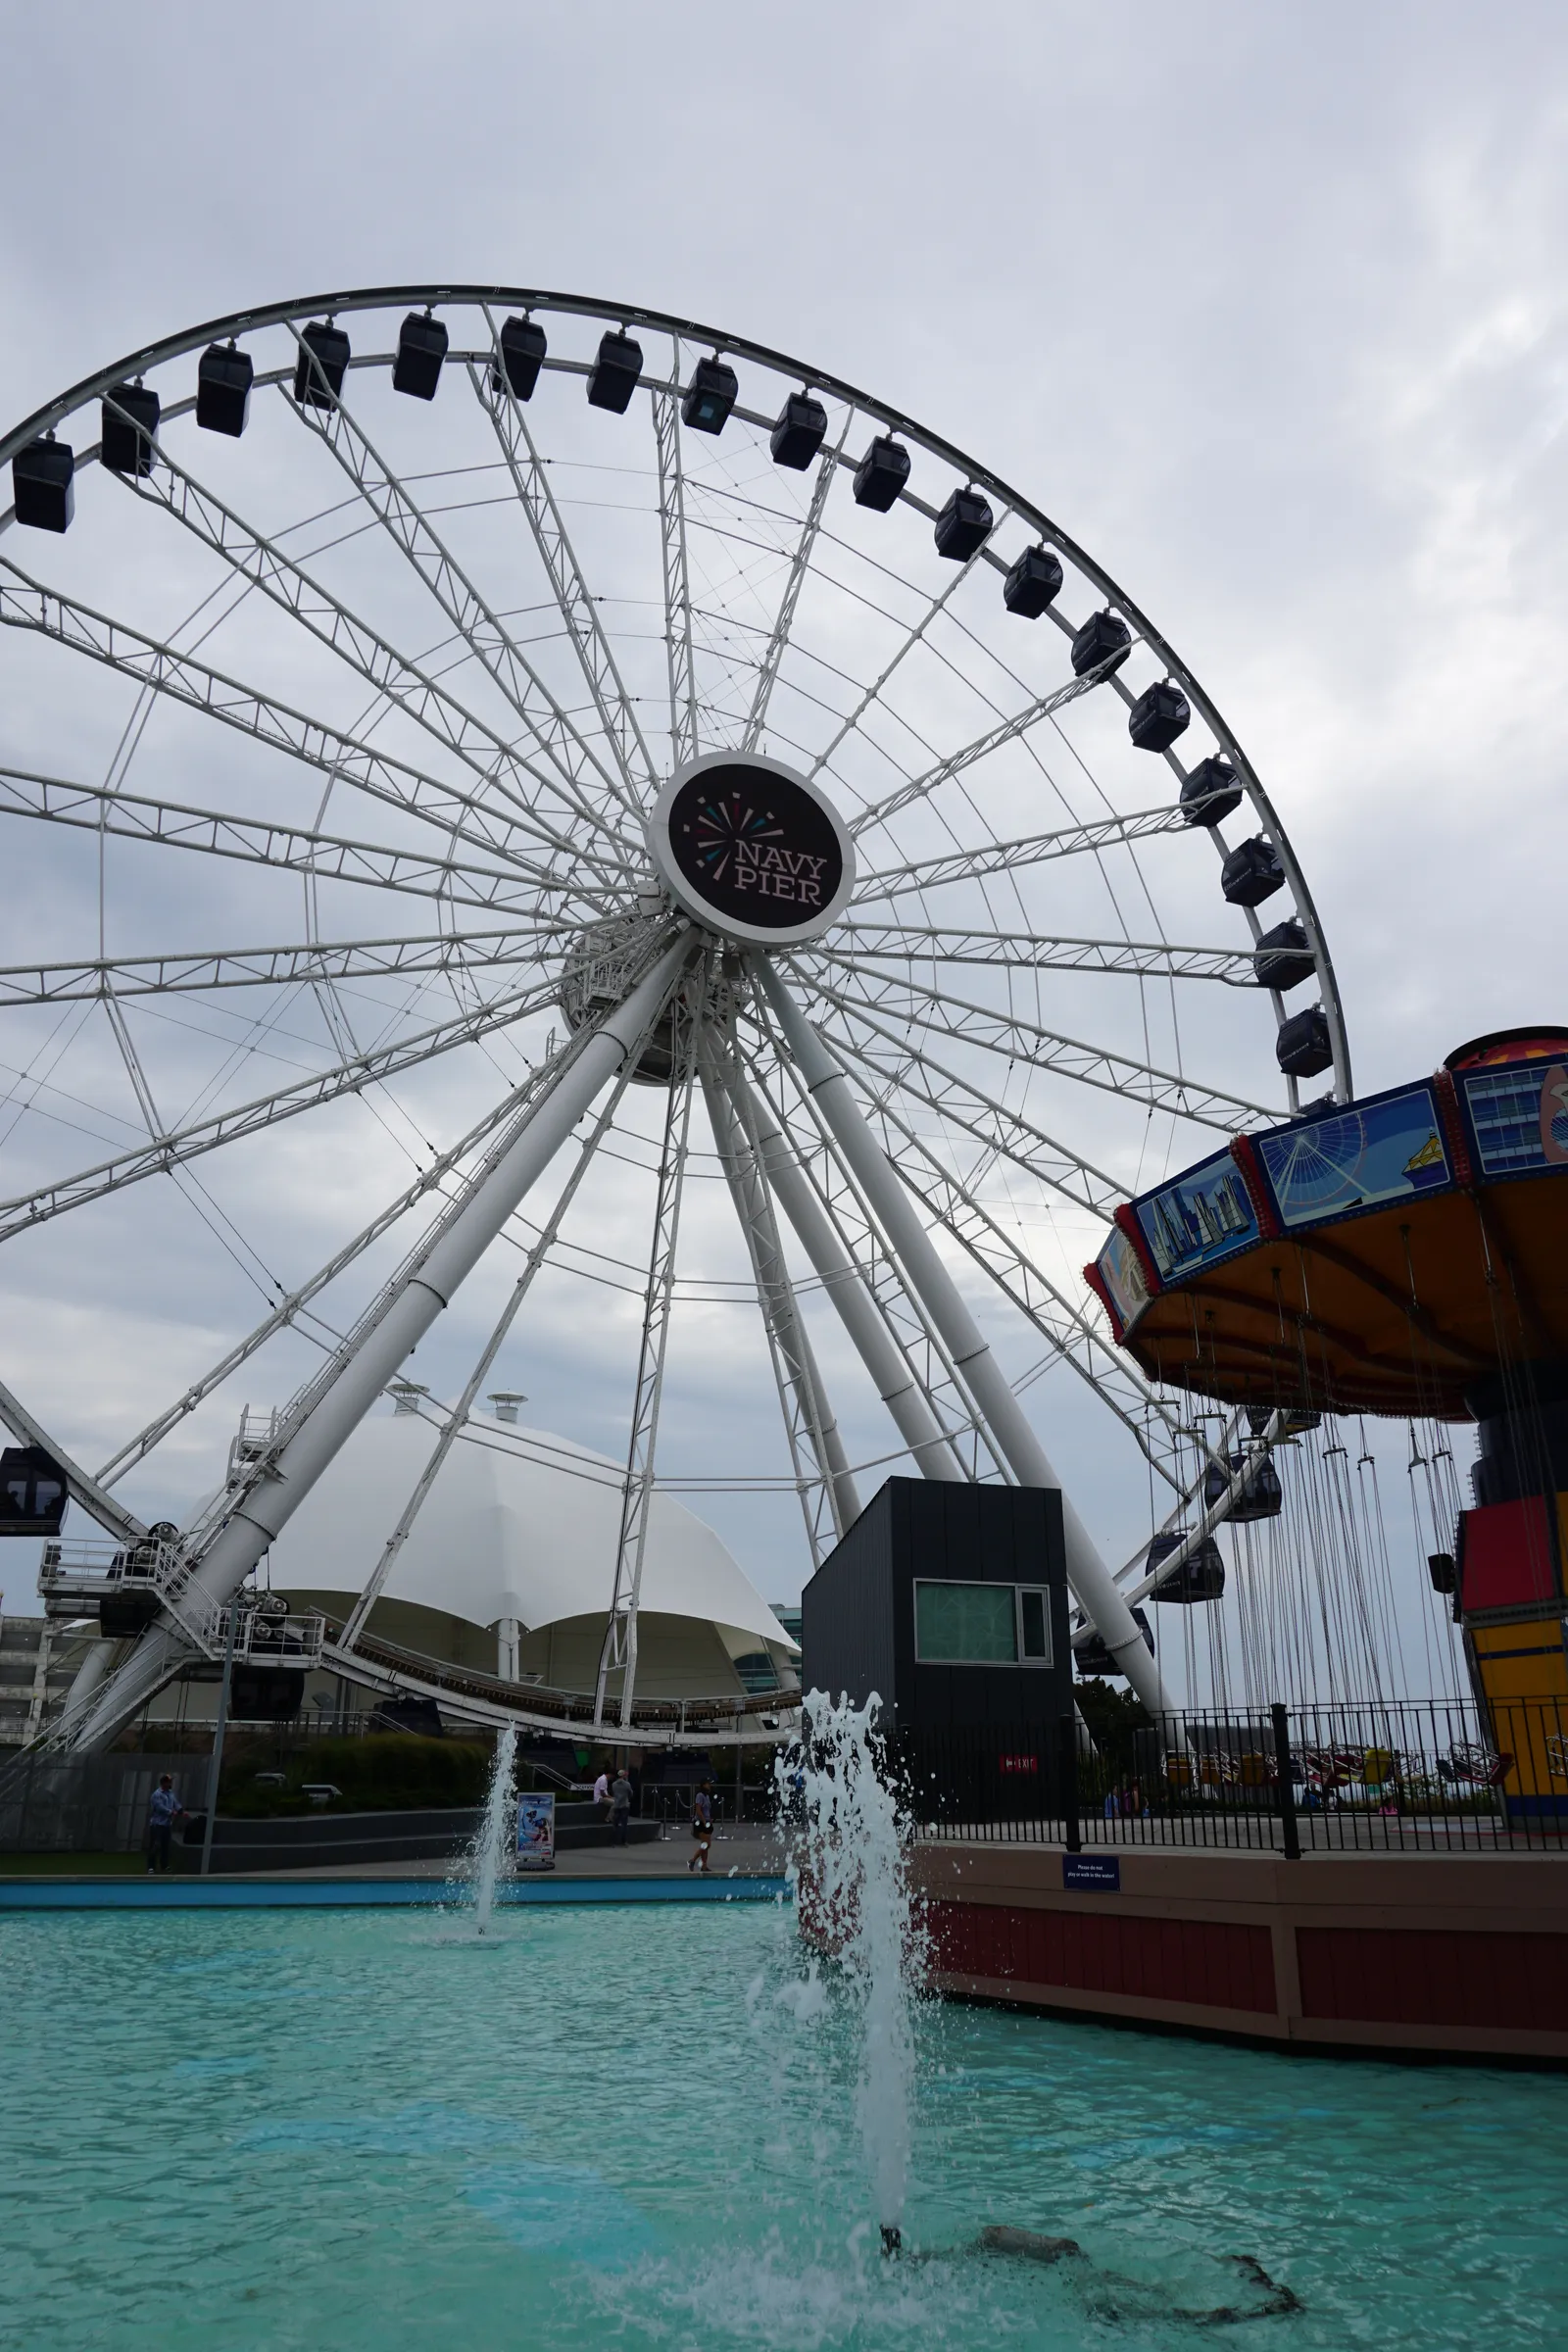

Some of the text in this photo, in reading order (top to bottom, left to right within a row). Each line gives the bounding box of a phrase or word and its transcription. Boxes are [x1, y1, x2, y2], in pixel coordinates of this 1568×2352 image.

[735, 839, 827, 880] NAVY
[734, 864, 821, 906] PIER
[1018, 1758, 1034, 1770] EXIT
